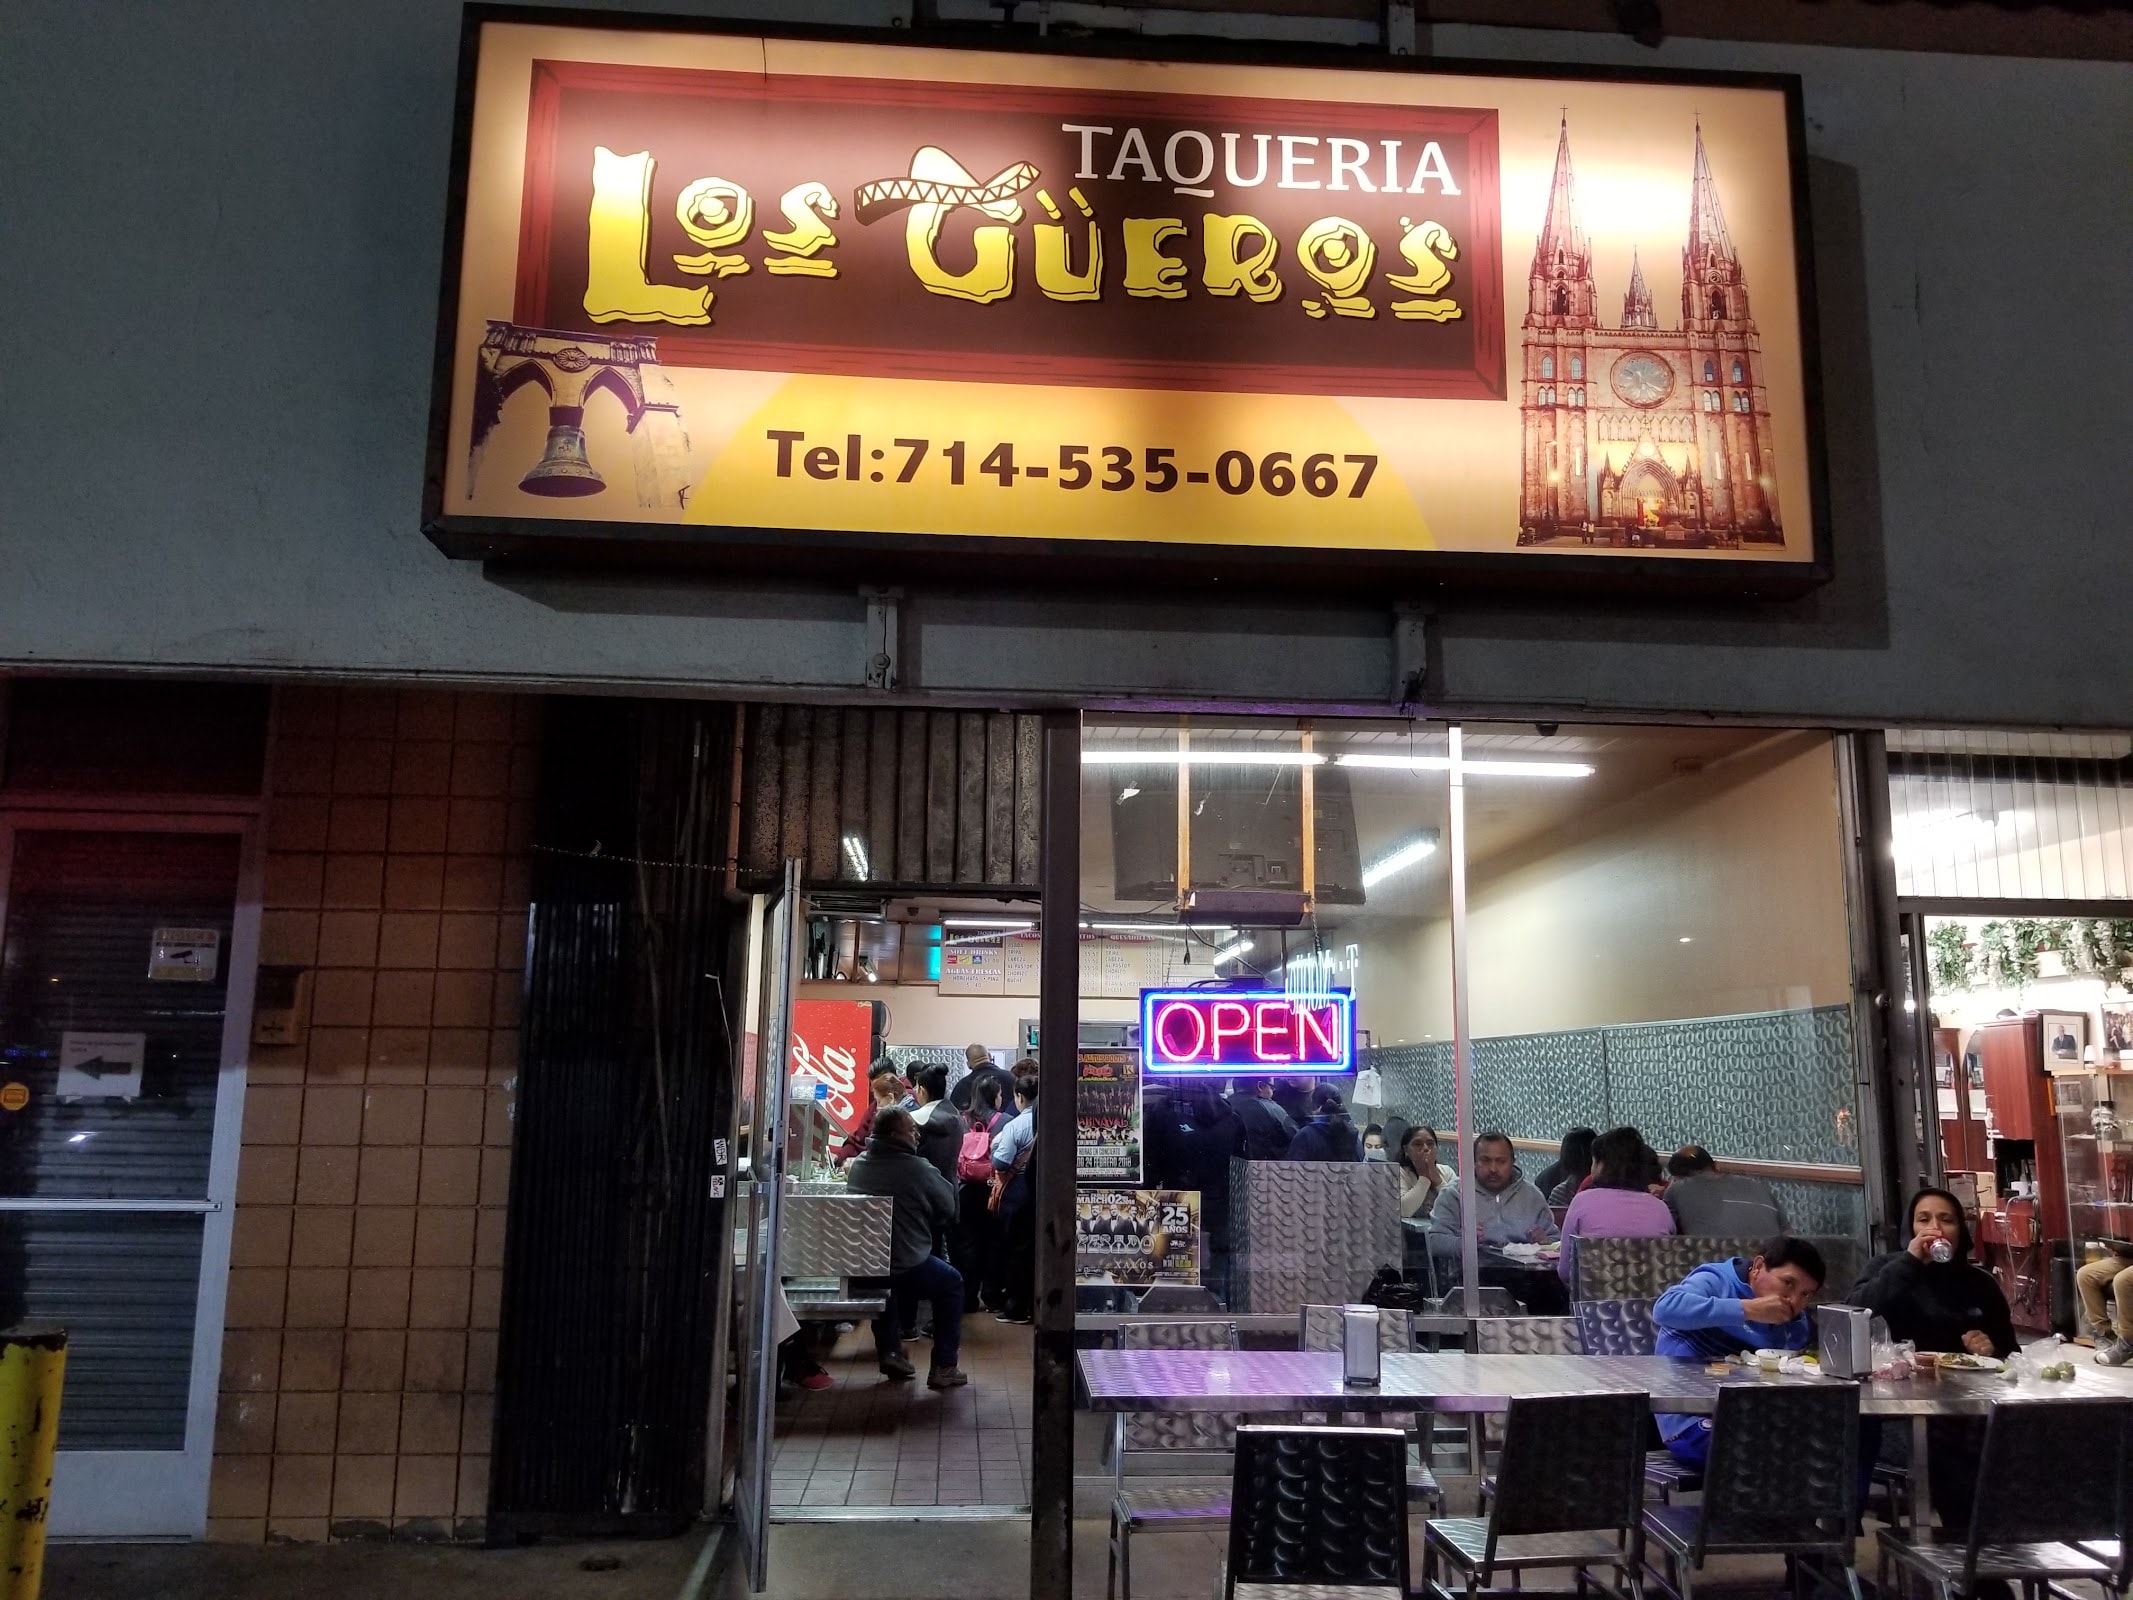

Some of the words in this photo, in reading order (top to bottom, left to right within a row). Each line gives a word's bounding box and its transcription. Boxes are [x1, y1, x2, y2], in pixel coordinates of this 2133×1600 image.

[1062, 123, 1461, 198] TAQUERIA
[767, 430, 1378, 498] Tel:714-535-0667
[1155, 1003, 1340, 1062] OPEN
[1094, 1156, 1118, 1168] FEBRERO
[1076, 1195, 1108, 1204] MARCH
[1161, 1206, 1189, 1226] 25
[1162, 1225, 1189, 1234] AÑOS
